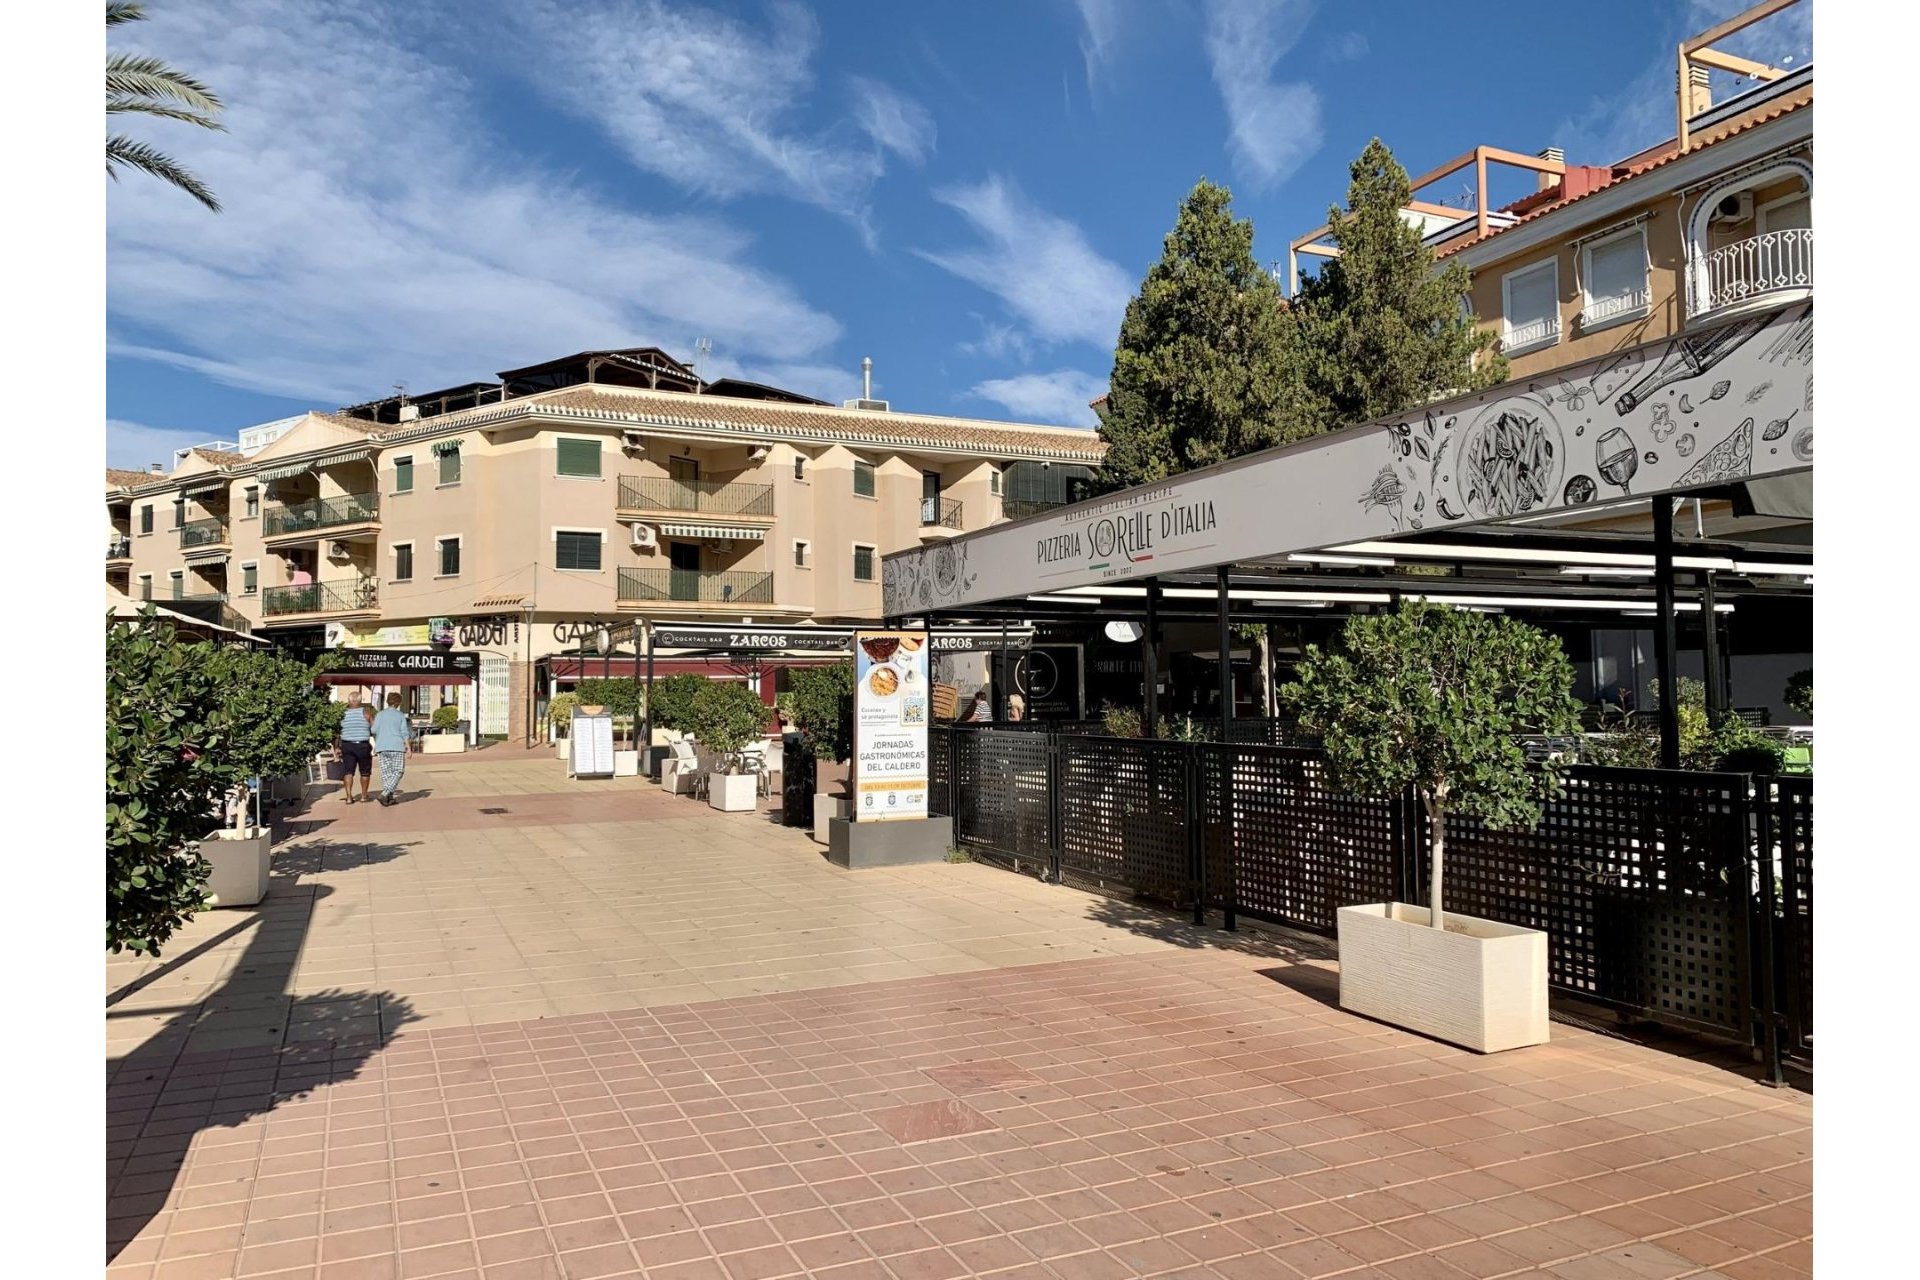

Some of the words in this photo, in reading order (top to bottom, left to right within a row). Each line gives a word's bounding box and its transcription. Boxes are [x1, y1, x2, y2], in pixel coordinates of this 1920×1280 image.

[1037, 532, 1082, 564] PIZZERIA
[1087, 510, 1154, 563] SORELLE
[1161, 500, 1217, 539] D'ITALIA
[730, 634, 787, 647] ZARCOS
[931, 637, 973, 649] ARCOS
[398, 655, 444, 668] GARDEN
[872, 740, 914, 749] JORNADAS
[860, 750, 926, 760] GASTRONÓMICAS
[867, 763, 882, 771] DEL
[885, 762, 921, 771] CALDERO
